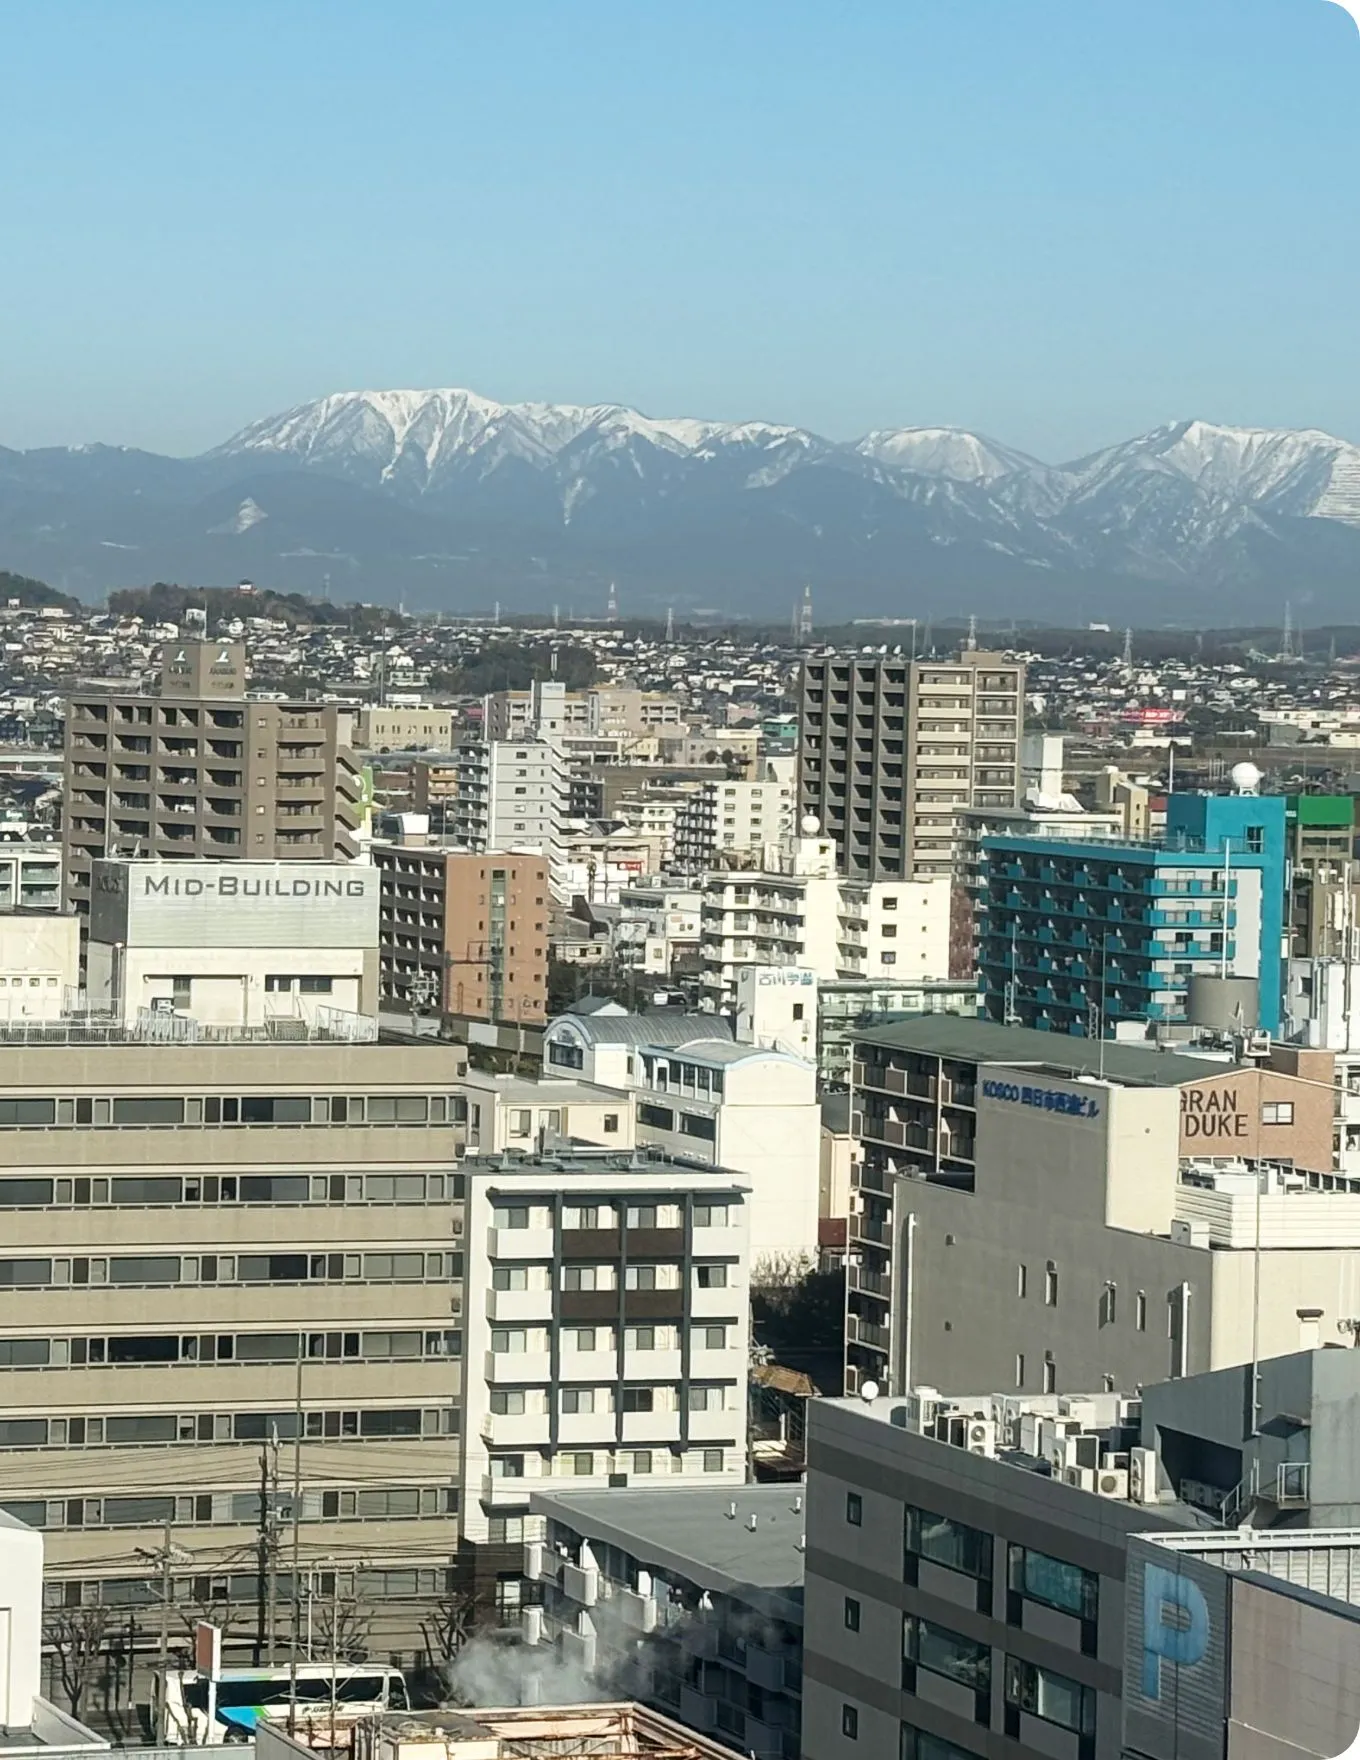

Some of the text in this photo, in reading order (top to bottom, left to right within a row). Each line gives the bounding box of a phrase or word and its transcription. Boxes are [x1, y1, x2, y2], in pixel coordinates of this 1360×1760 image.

[144, 875, 365, 897] MID-BUILDING
[1185, 1114, 1248, 1137] DUKE
[1143, 1561, 1210, 1700] P
